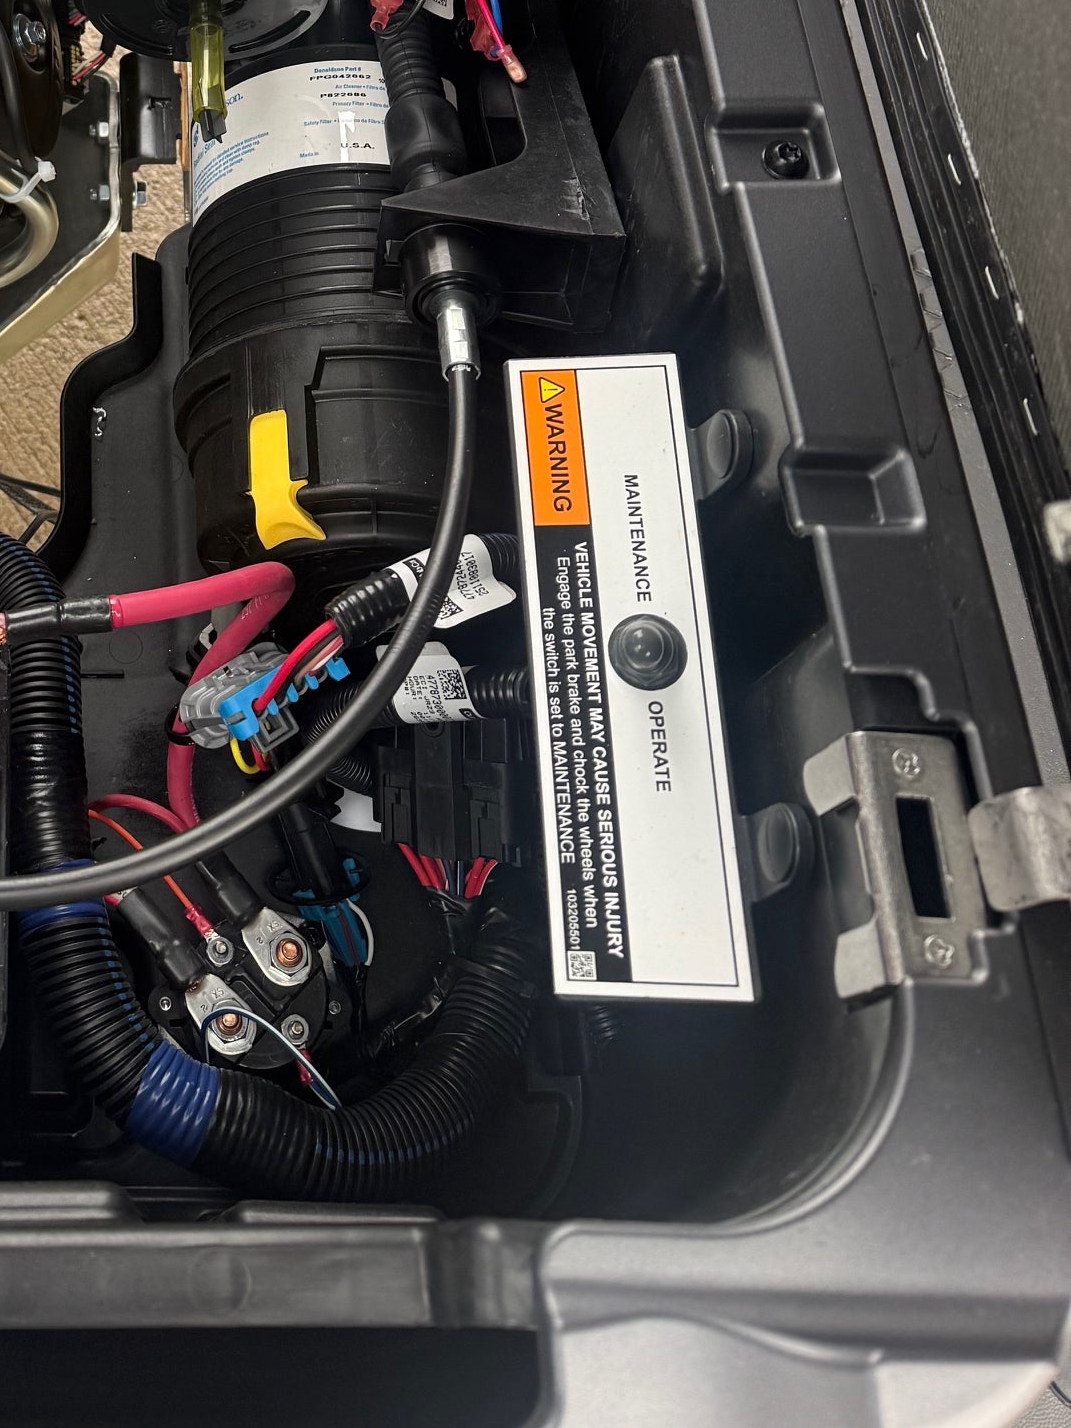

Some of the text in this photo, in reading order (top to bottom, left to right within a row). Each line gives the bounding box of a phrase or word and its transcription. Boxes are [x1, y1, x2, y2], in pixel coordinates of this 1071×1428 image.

[544, 403, 572, 512] WARNING
[623, 474, 651, 602] MAINTENANCE
[542, 607, 575, 863] the switch is set to MAINTENANCE
[553, 557, 600, 927] Engage the park brake and chock the wheels when
[573, 541, 625, 958] VEHICLE MOVEMENT MAY CAUSE SERIOUS INJURY
[647, 701, 672, 792] OPERATE
[565, 888, 581, 950] 103205501
